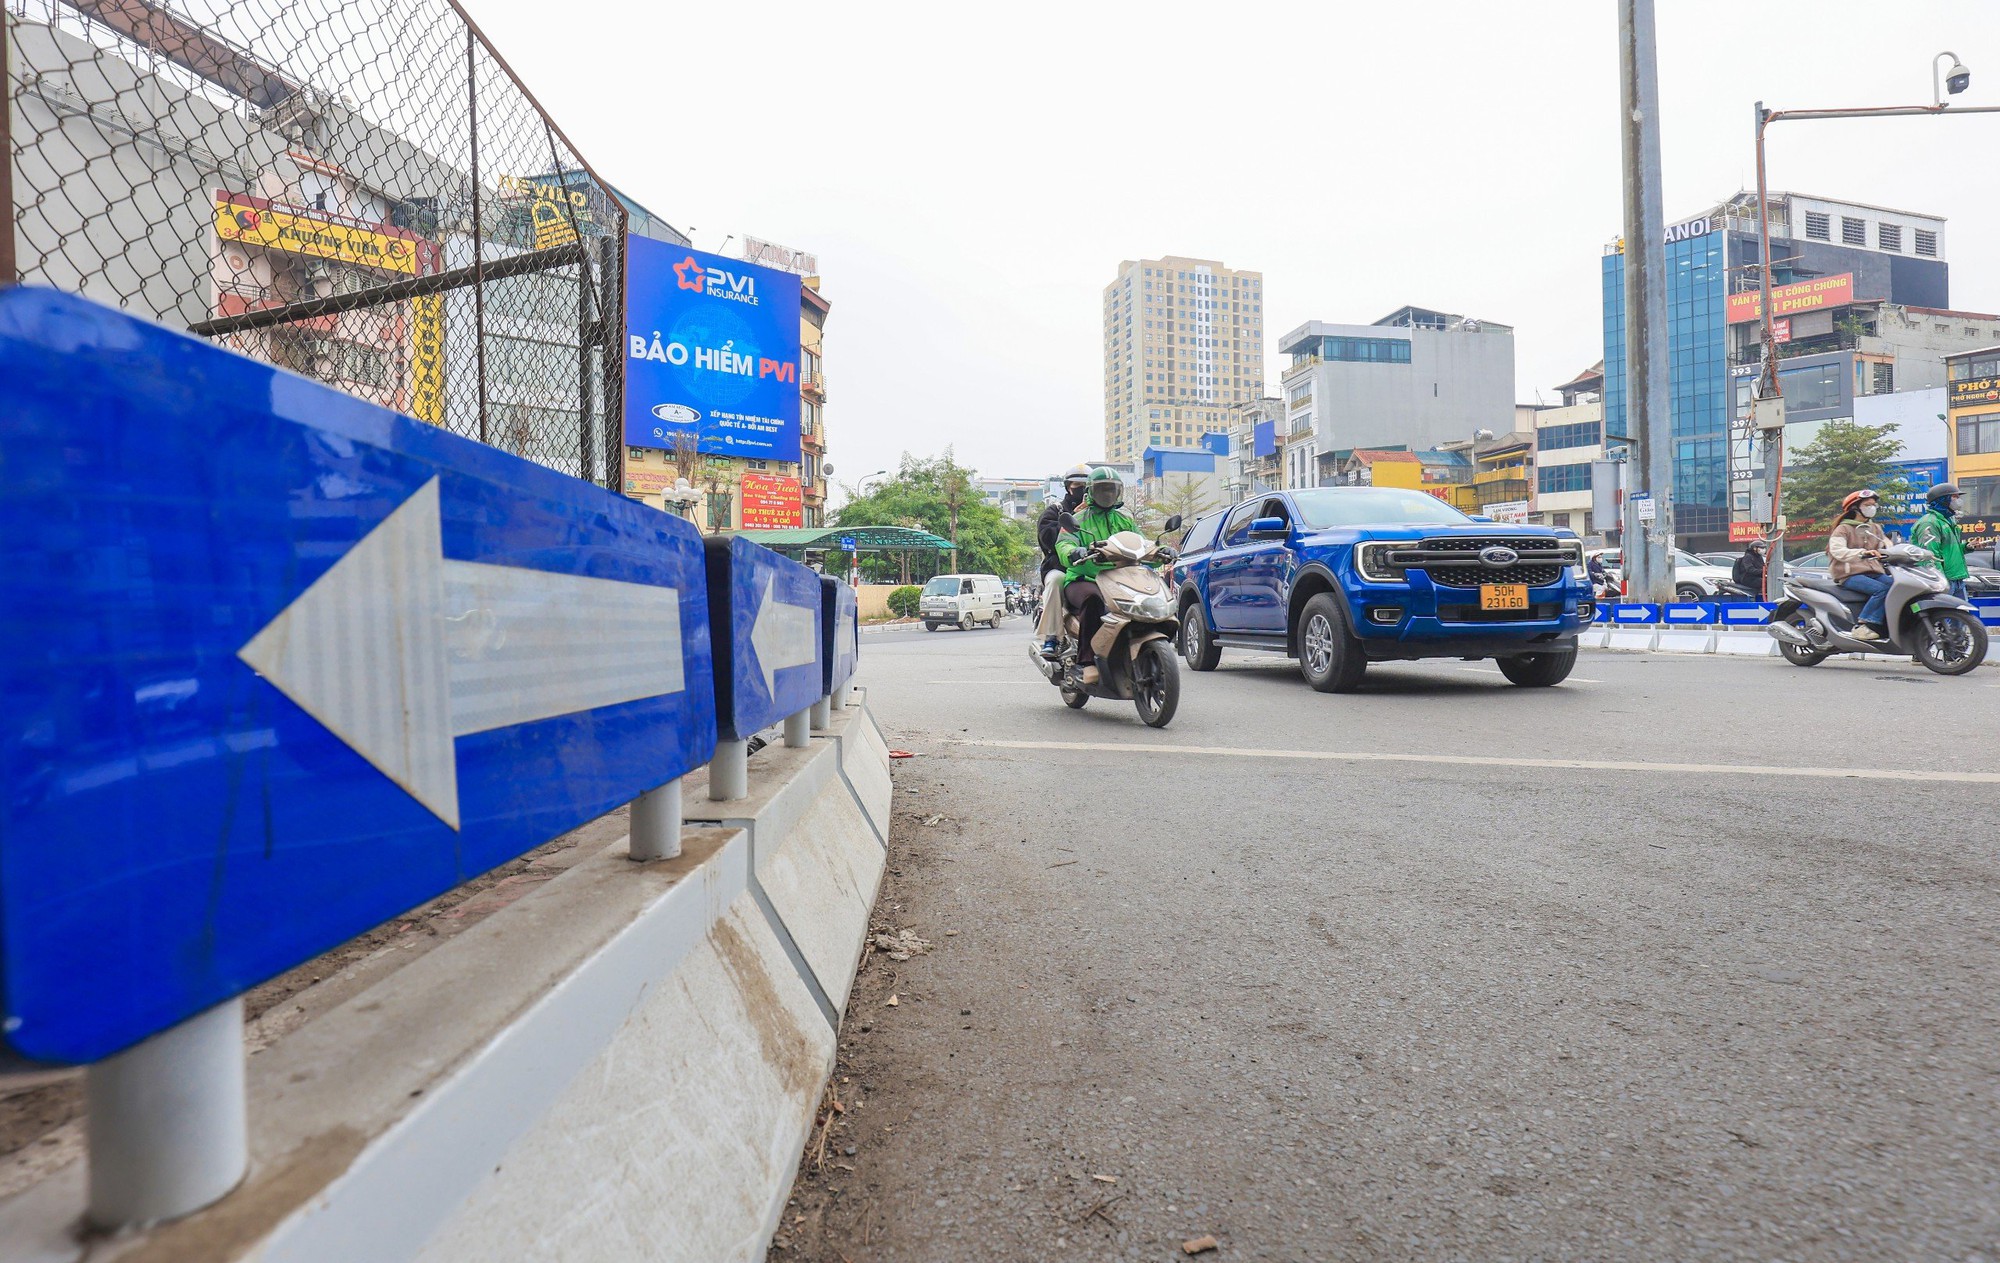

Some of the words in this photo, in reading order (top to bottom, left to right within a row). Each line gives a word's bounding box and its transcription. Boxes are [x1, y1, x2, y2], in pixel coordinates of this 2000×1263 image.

[1664, 217, 1711, 244] ANOI
[706, 267, 754, 295] PVI
[706, 286, 758, 306] INSURANCE
[1732, 295, 1750, 306] VĂN
[1752, 290, 1783, 303] PNG
[1786, 284, 1810, 296] CÔNG
[1814, 278, 1847, 290] CHỨNG
[630, 331, 688, 366] BẢO
[695, 340, 752, 376] HIỂM
[759, 358, 794, 384] PVI
[1731, 366, 1752, 376] 393
[1958, 378, 1990, 392] PHỞ
[1733, 471, 1753, 479] 393
[744, 480, 768, 490] Hoa
[1733, 526, 1745, 535] VĂN
[1492, 552, 1510, 561] Ford
[1494, 586, 1514, 596] 50H
[1486, 598, 1523, 608] 231.60
